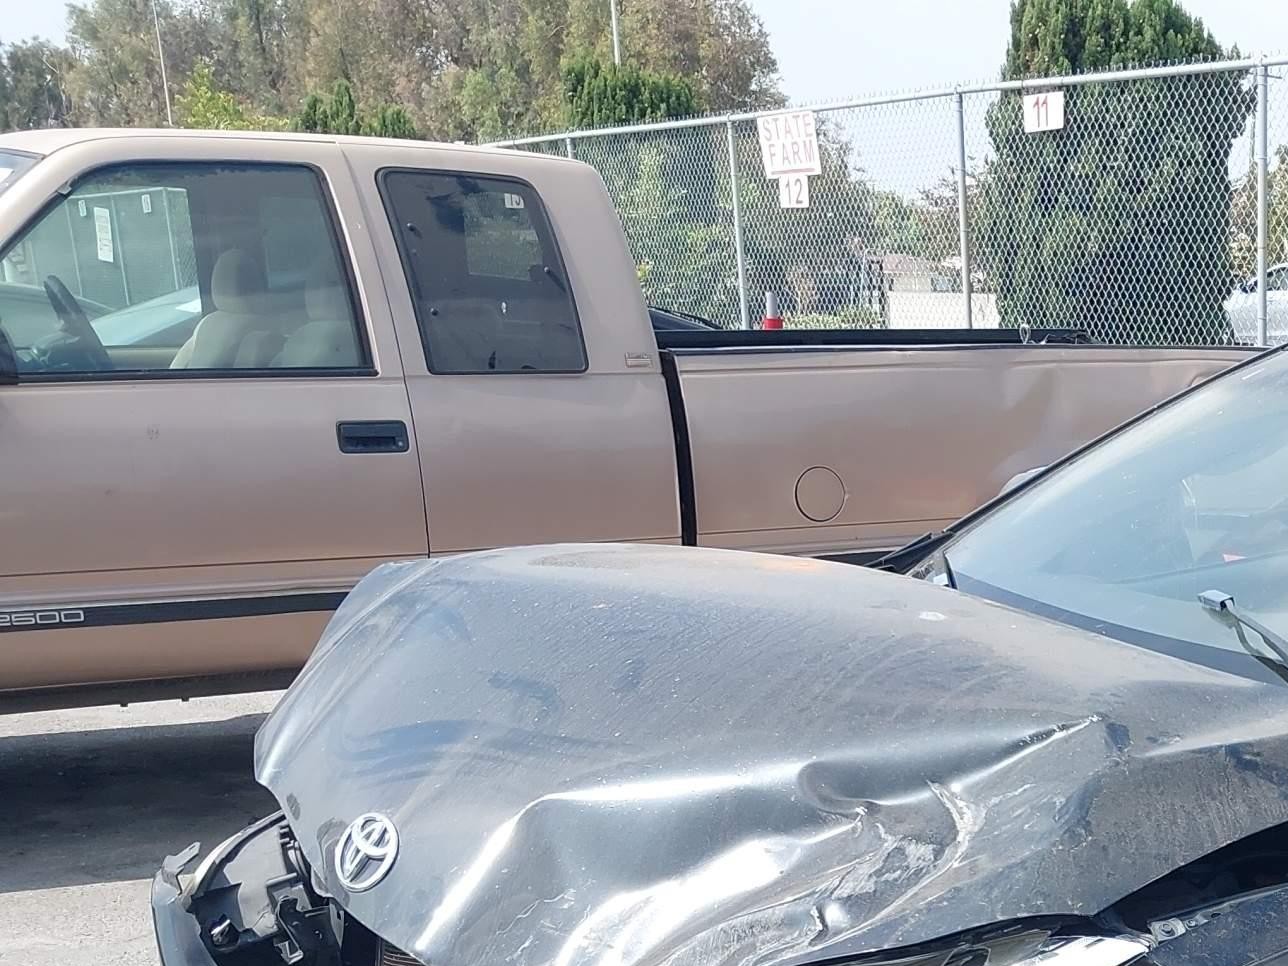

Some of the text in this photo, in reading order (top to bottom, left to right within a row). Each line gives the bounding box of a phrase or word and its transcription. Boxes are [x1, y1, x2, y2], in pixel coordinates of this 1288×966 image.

[1033, 95, 1050, 129] 11
[762, 113, 814, 142] STATE
[768, 139, 816, 168] FARM
[784, 178, 804, 206] 12
